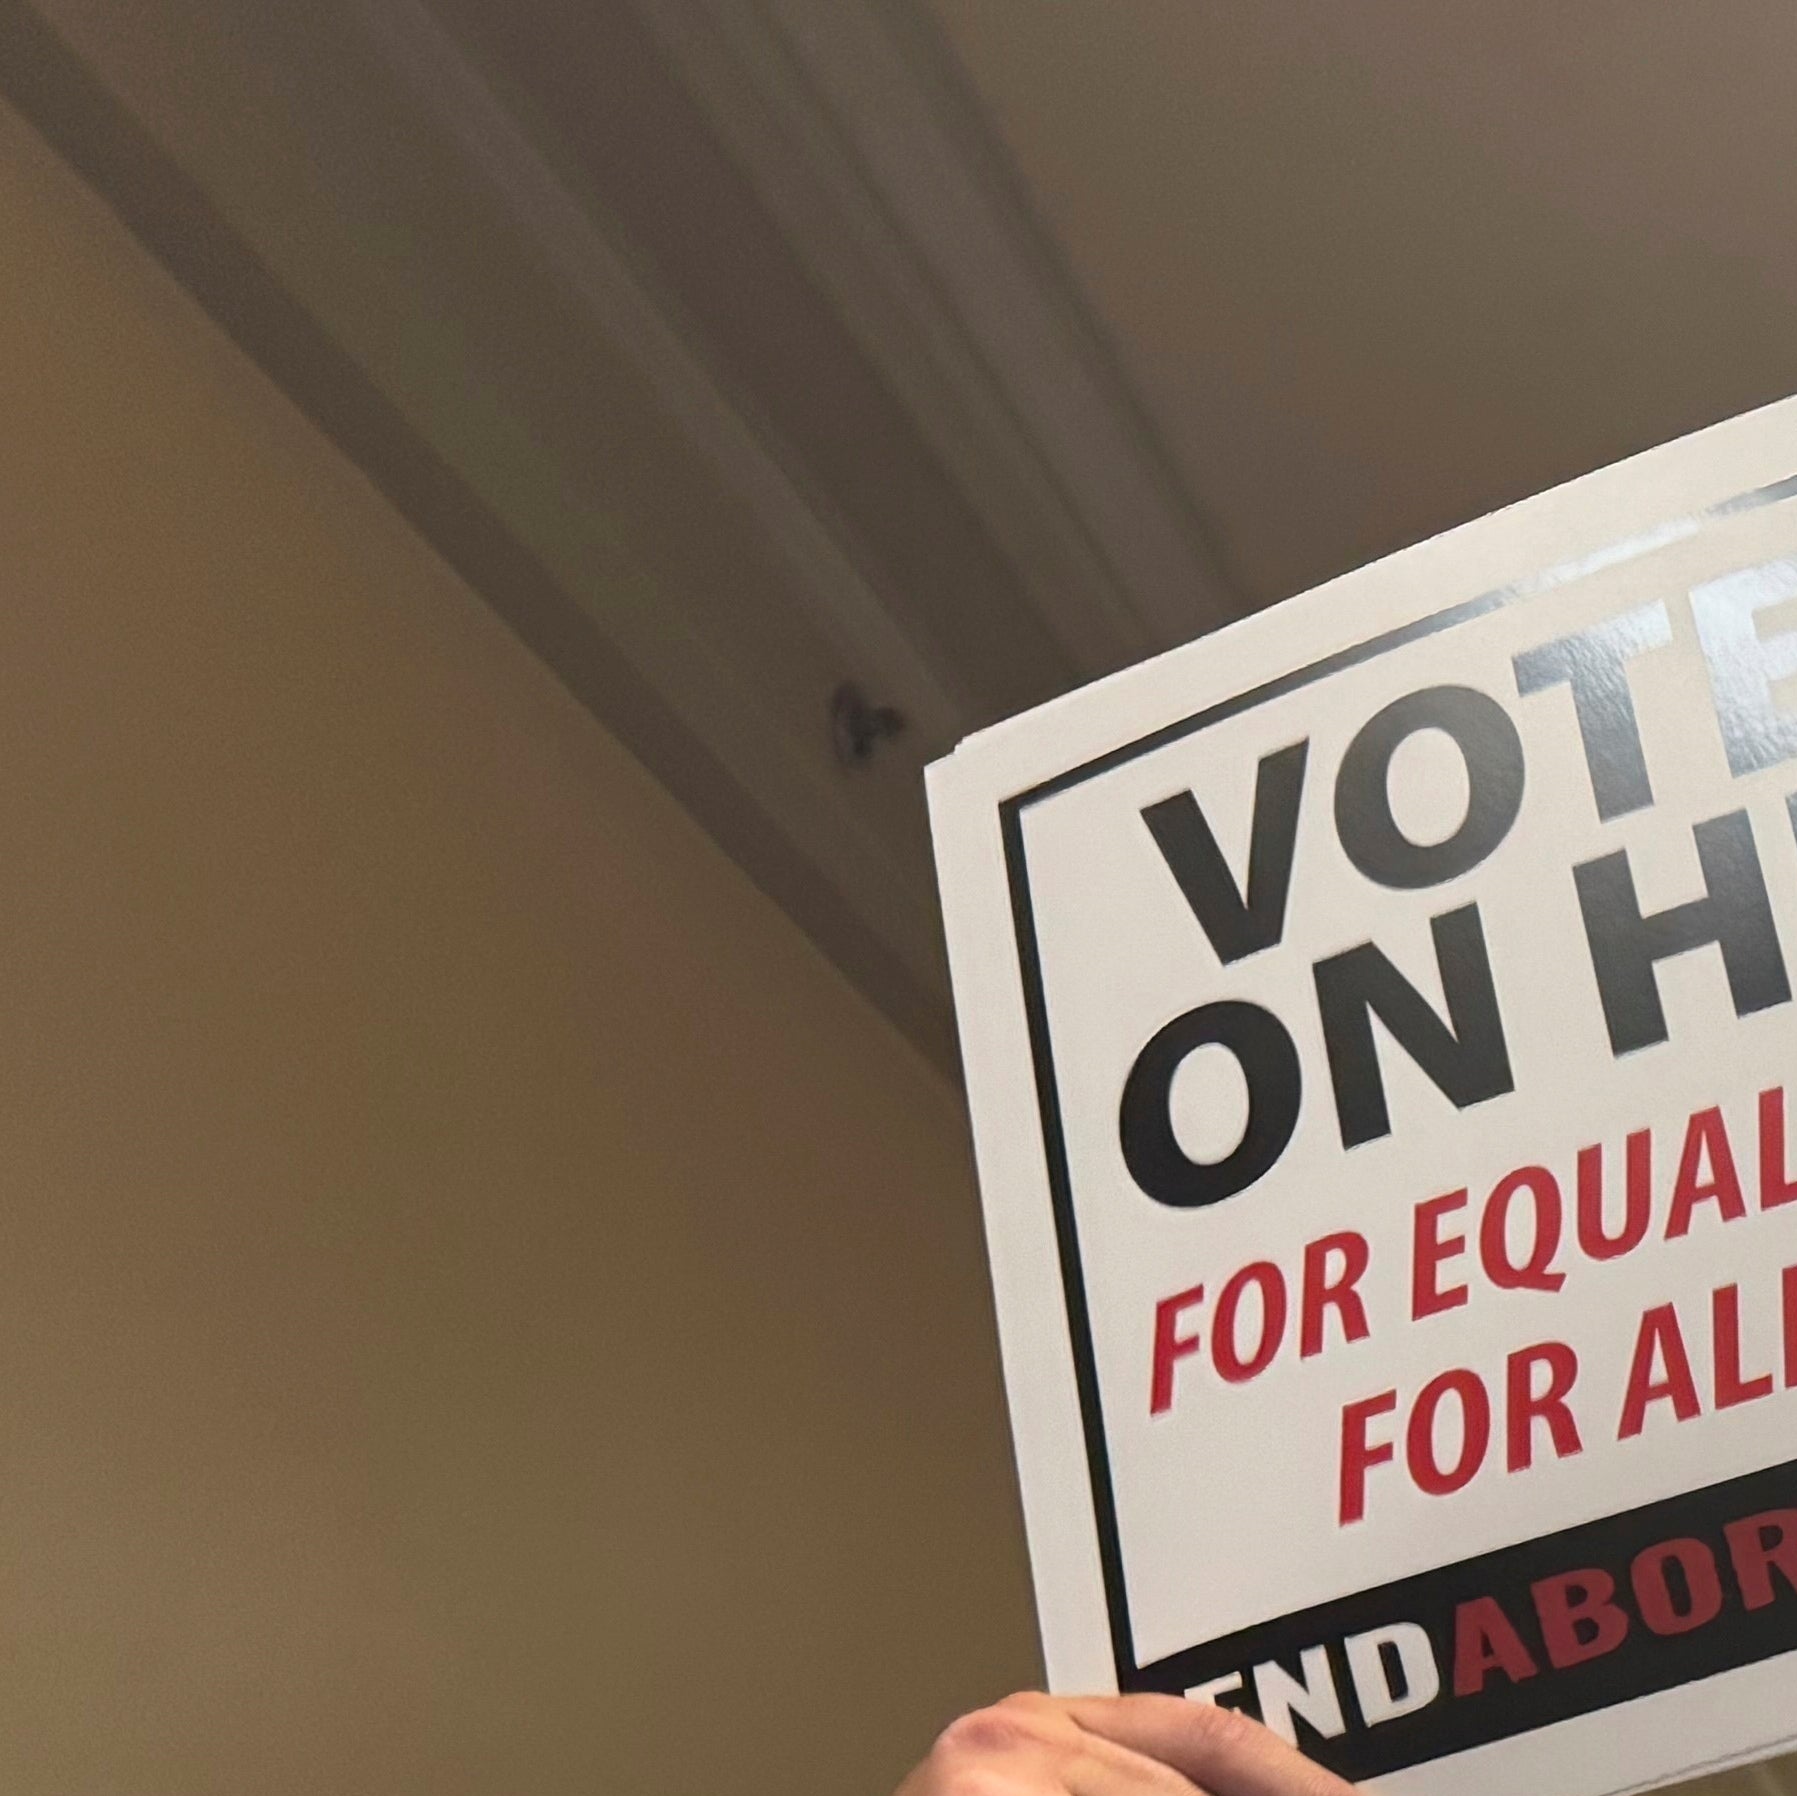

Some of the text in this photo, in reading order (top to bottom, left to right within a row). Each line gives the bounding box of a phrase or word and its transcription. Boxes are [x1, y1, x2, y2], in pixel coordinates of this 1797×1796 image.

[1118, 913, 1515, 1210] ON
[1147, 1229, 1370, 1419] FOR
[1337, 1340, 1584, 1524] FOR
